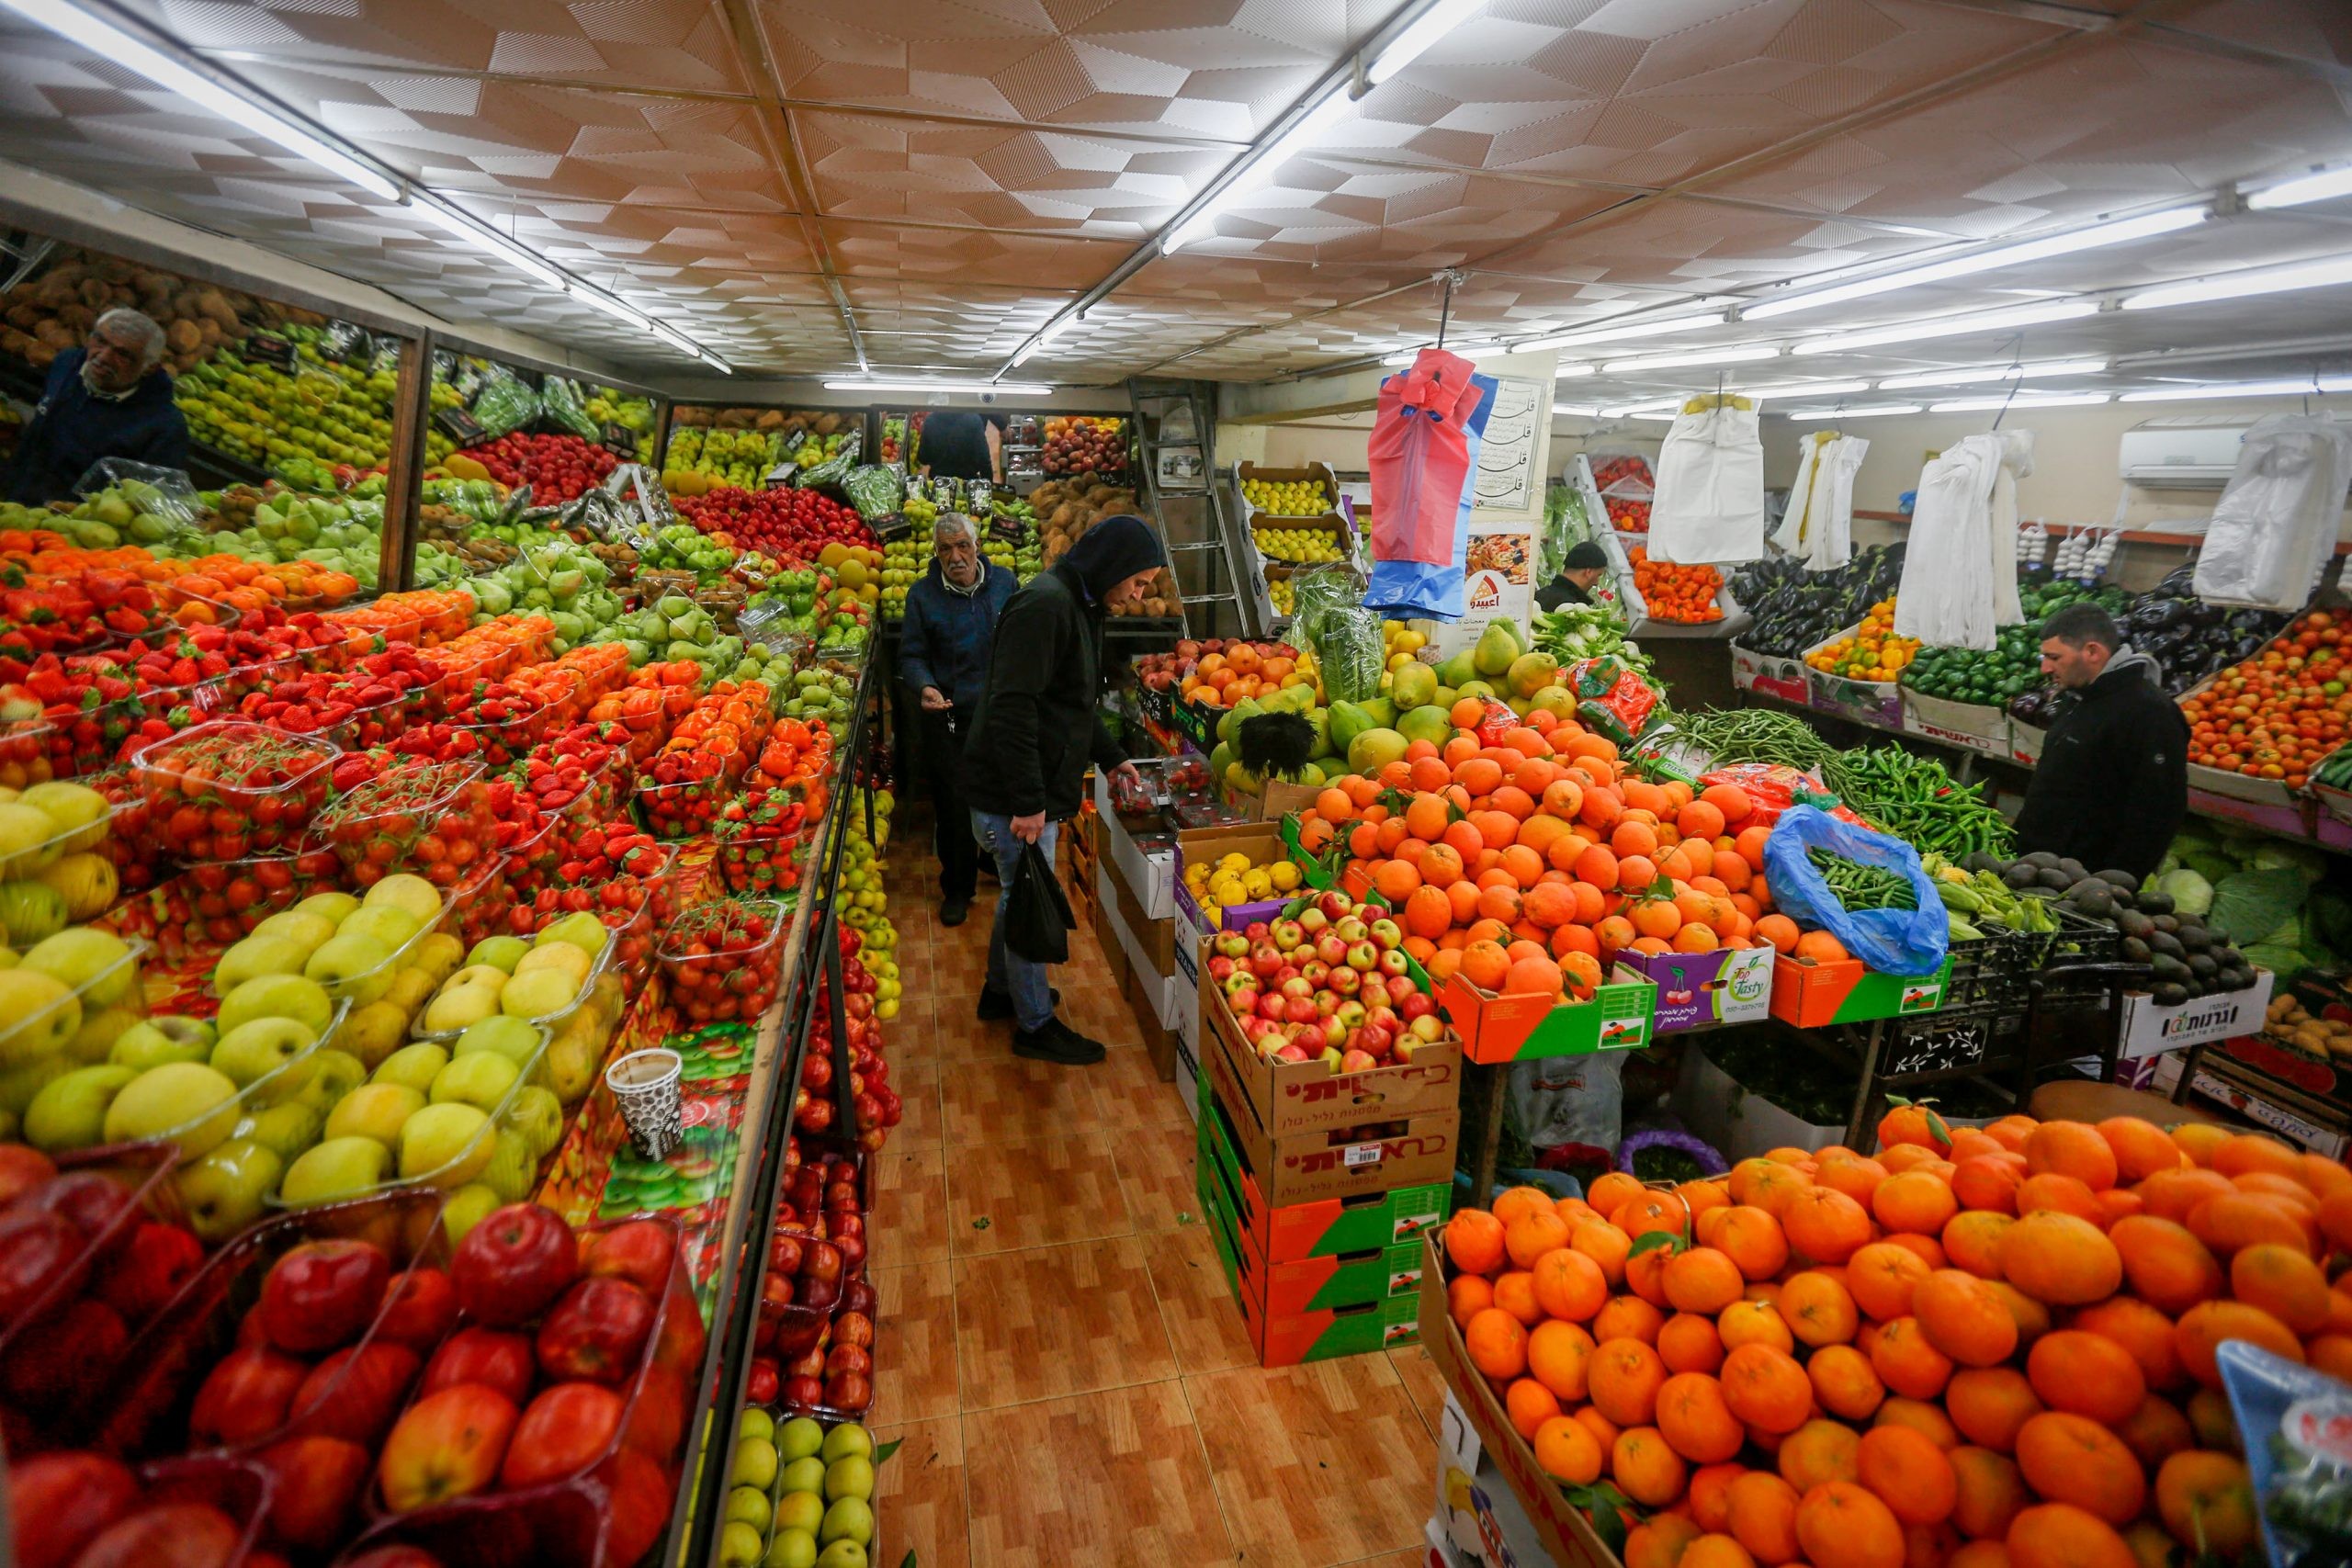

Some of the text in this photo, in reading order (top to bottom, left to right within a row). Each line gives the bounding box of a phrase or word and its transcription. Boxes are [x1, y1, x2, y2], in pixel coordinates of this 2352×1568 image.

[1735, 967, 1750, 981] Top
[1735, 980, 1764, 995] Tasty
[2187, 1010, 2229, 1031] גרנות
